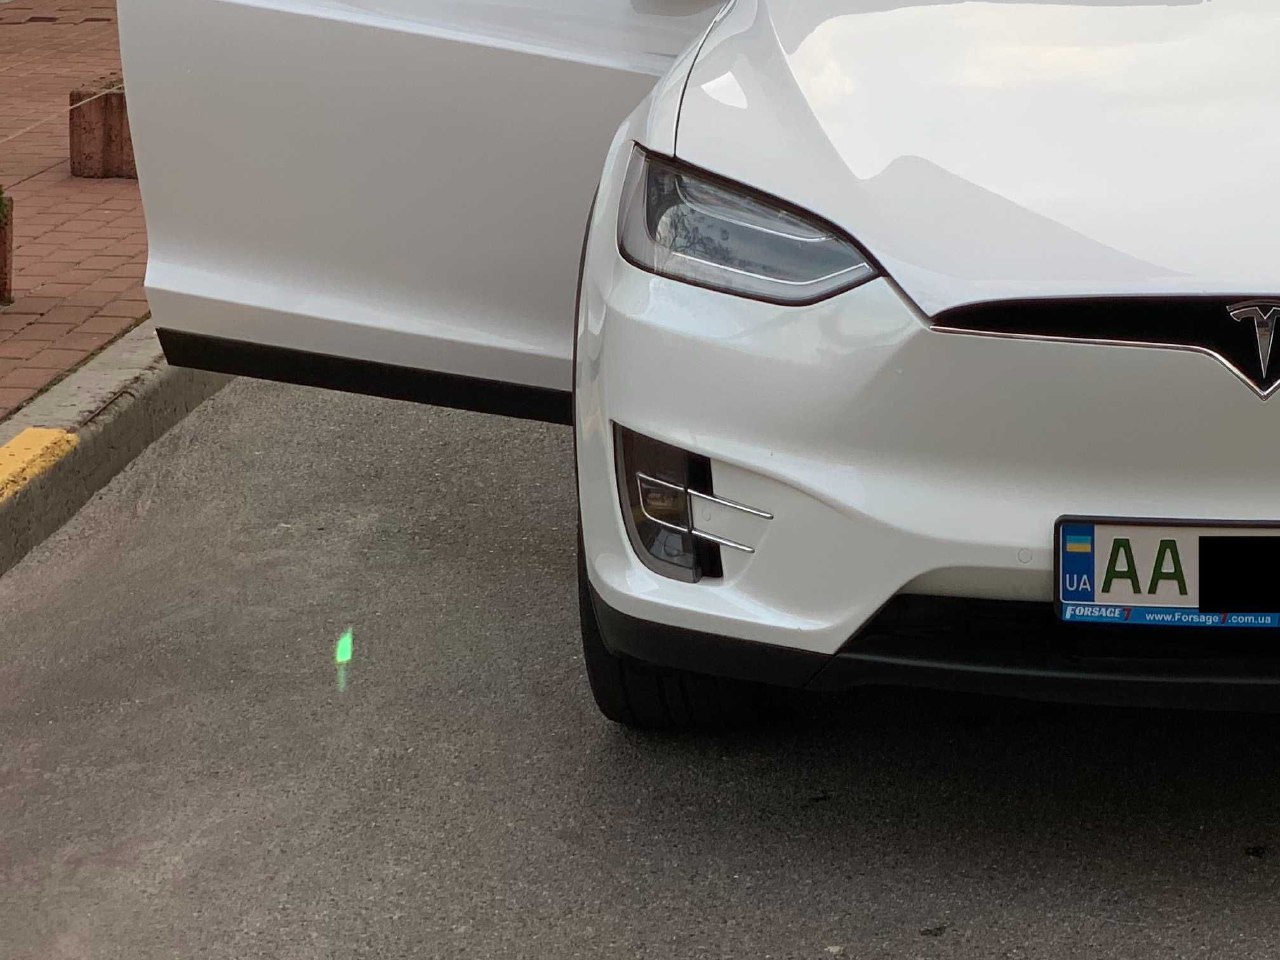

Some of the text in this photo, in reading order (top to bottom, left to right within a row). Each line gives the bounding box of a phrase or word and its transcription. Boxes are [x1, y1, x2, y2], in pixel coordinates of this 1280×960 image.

[1101, 538, 1188, 595] AA
[1065, 574, 1092, 592] UA
[1145, 612, 1272, 625] www.Forsage7.com.ua
